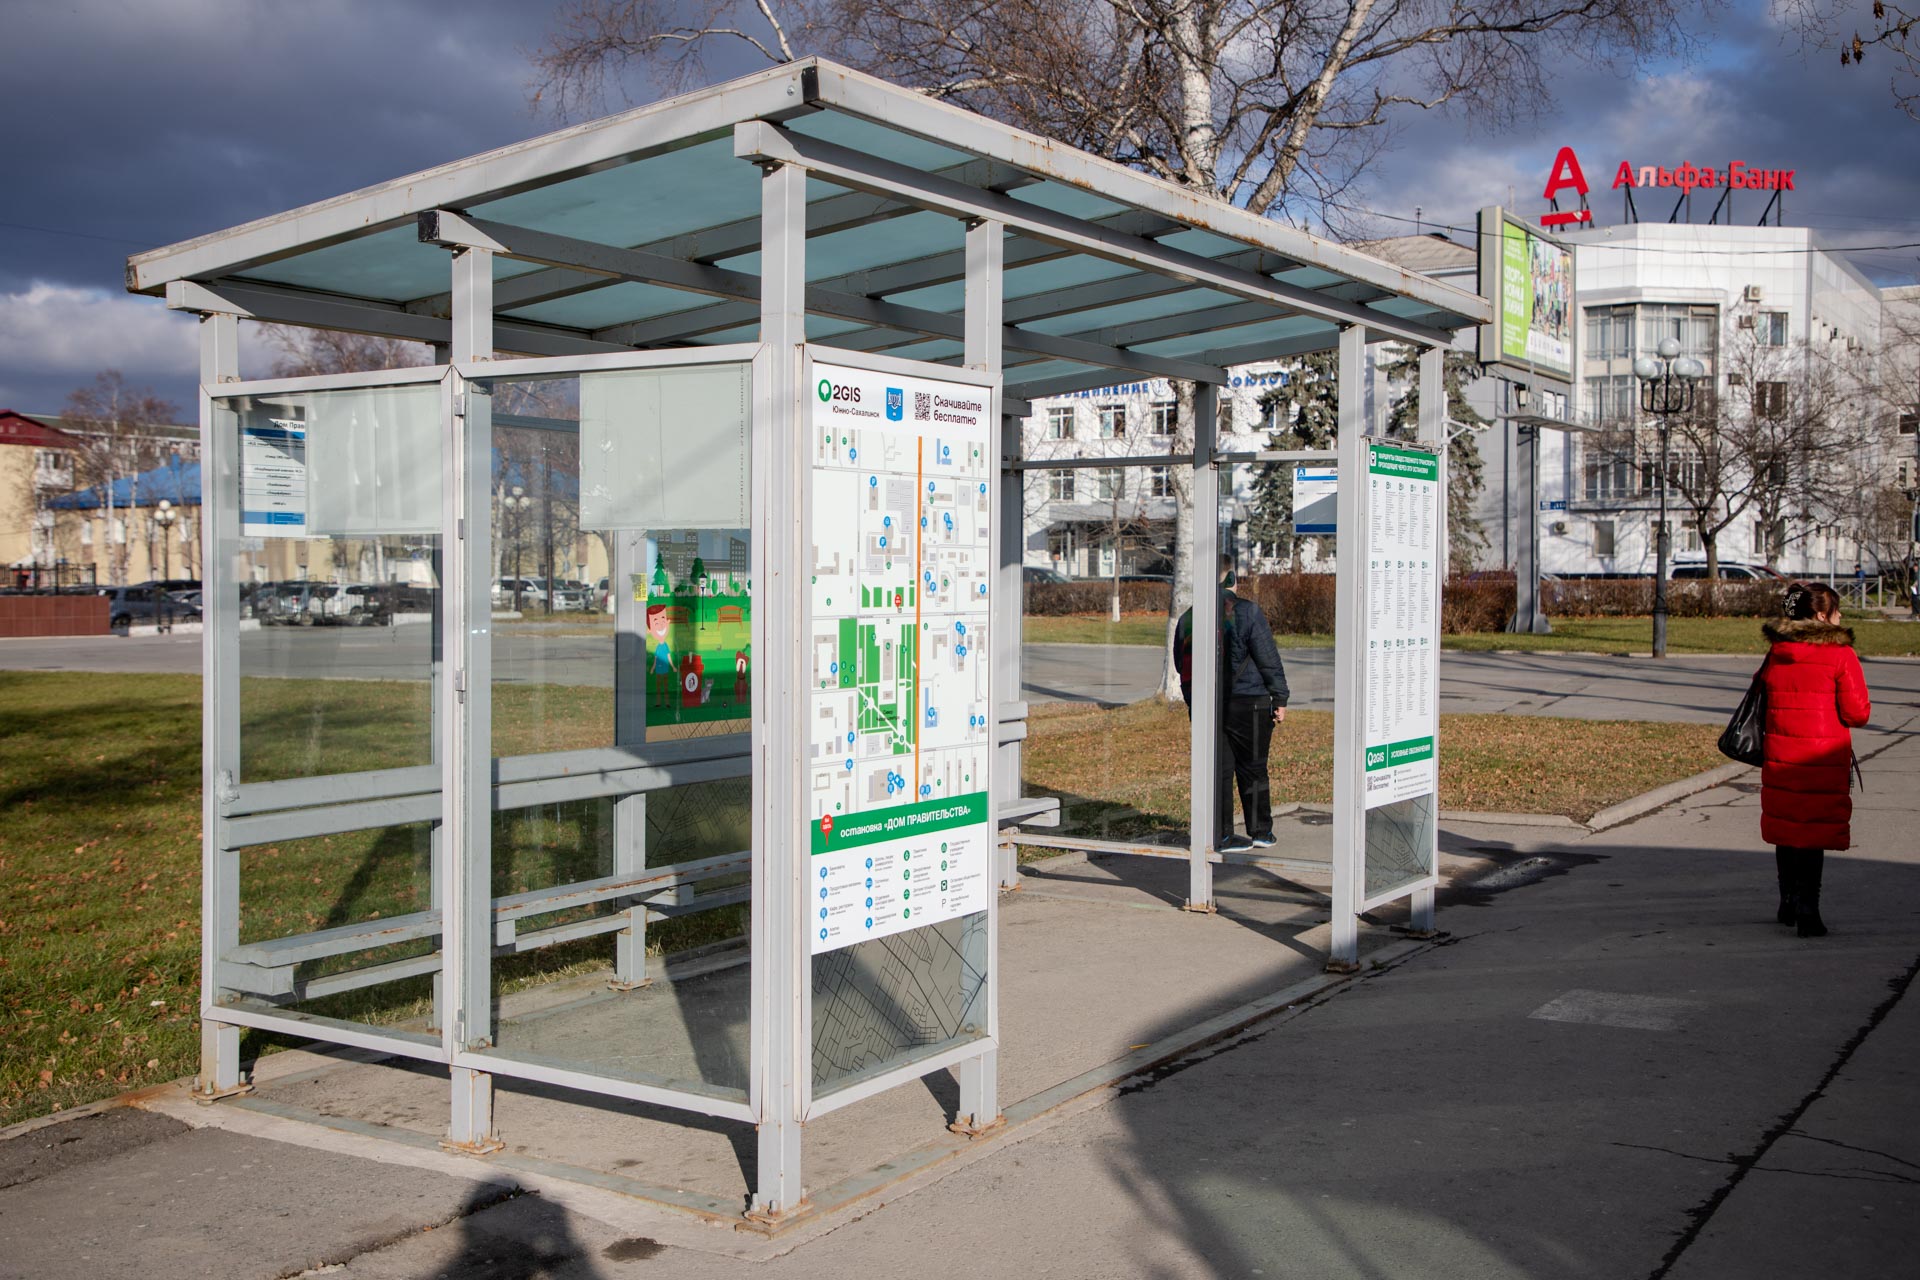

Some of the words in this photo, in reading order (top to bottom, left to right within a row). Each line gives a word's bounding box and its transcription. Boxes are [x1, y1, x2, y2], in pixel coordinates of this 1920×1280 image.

[833, 384, 861, 402] 2GIS
[934, 395, 982, 412] Скачивайте
[933, 410, 977, 426] бесплатно
[1373, 752, 1384, 763] 2GIS
[840, 821, 882, 838] остановка
[883, 817, 905, 831] «ДОМ
[906, 805, 971, 826] ПРАВИТЕЛЬСТВА»
